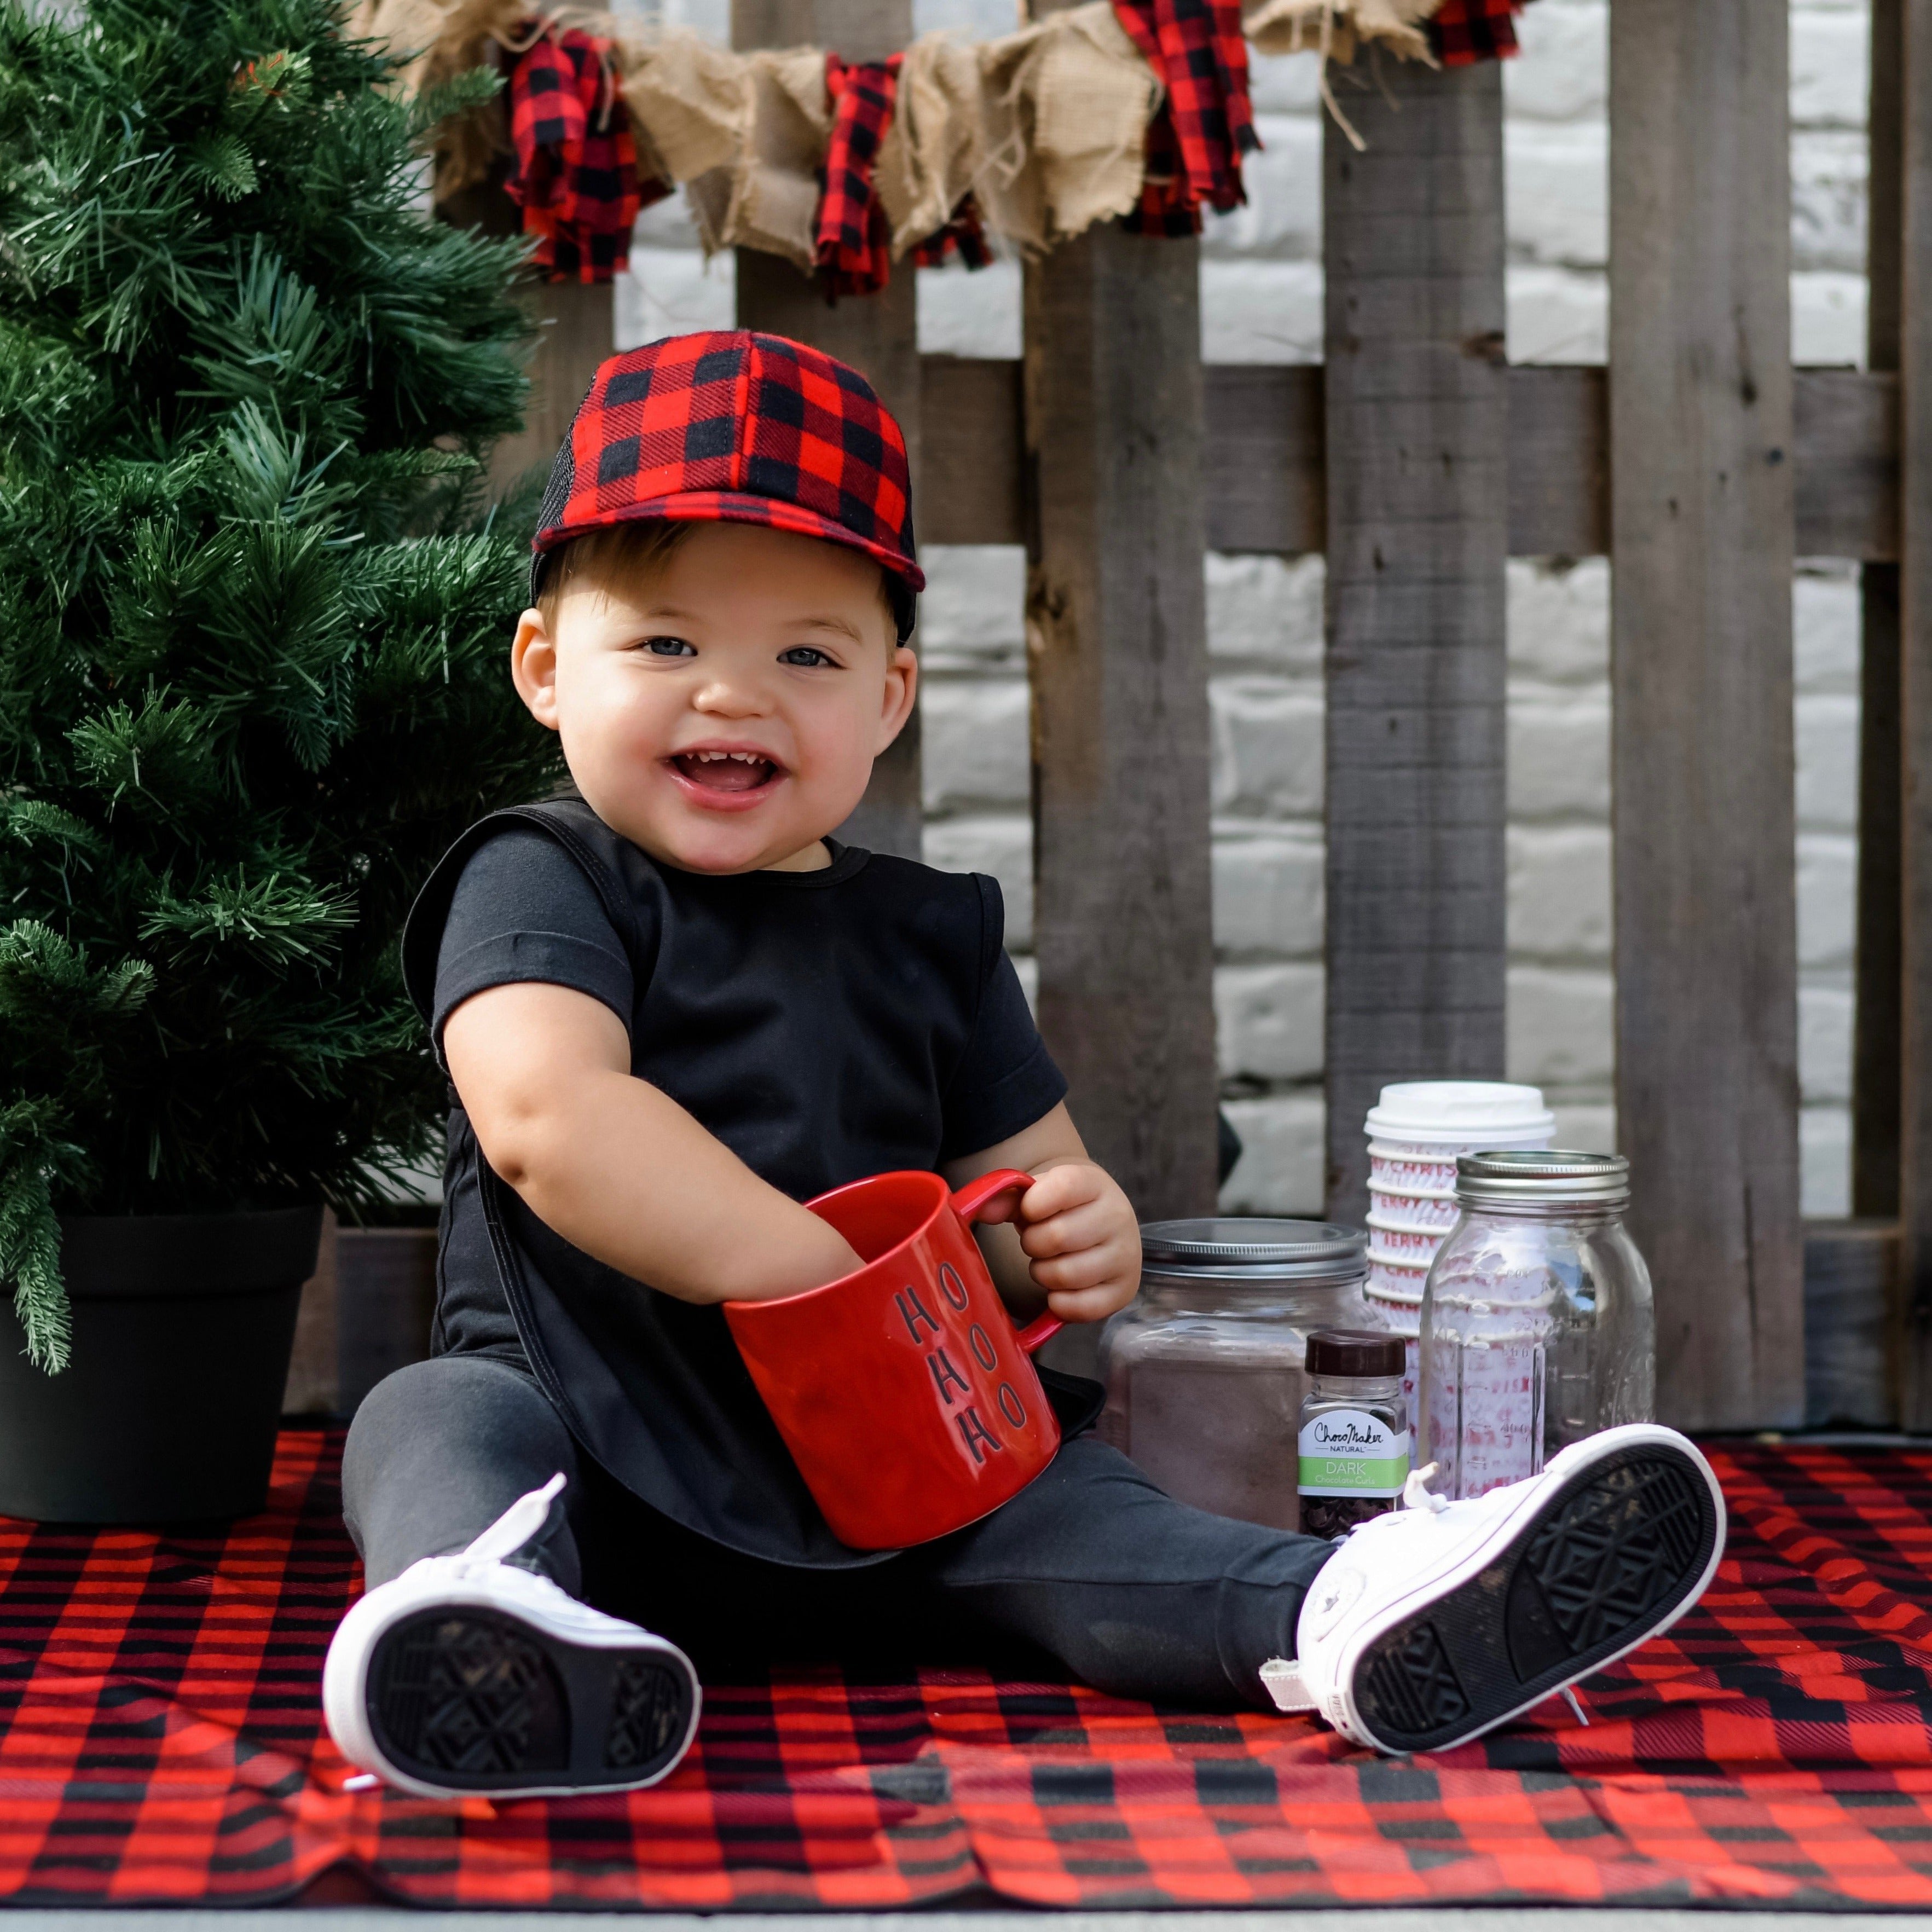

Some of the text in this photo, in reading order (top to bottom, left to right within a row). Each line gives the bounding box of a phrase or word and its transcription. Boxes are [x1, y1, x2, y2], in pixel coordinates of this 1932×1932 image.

[1315, 1422, 1384, 1444] ChocoMaker
[1326, 1461, 1367, 1475] DARK
[1315, 1475, 1376, 1485] Chocolate Curls
